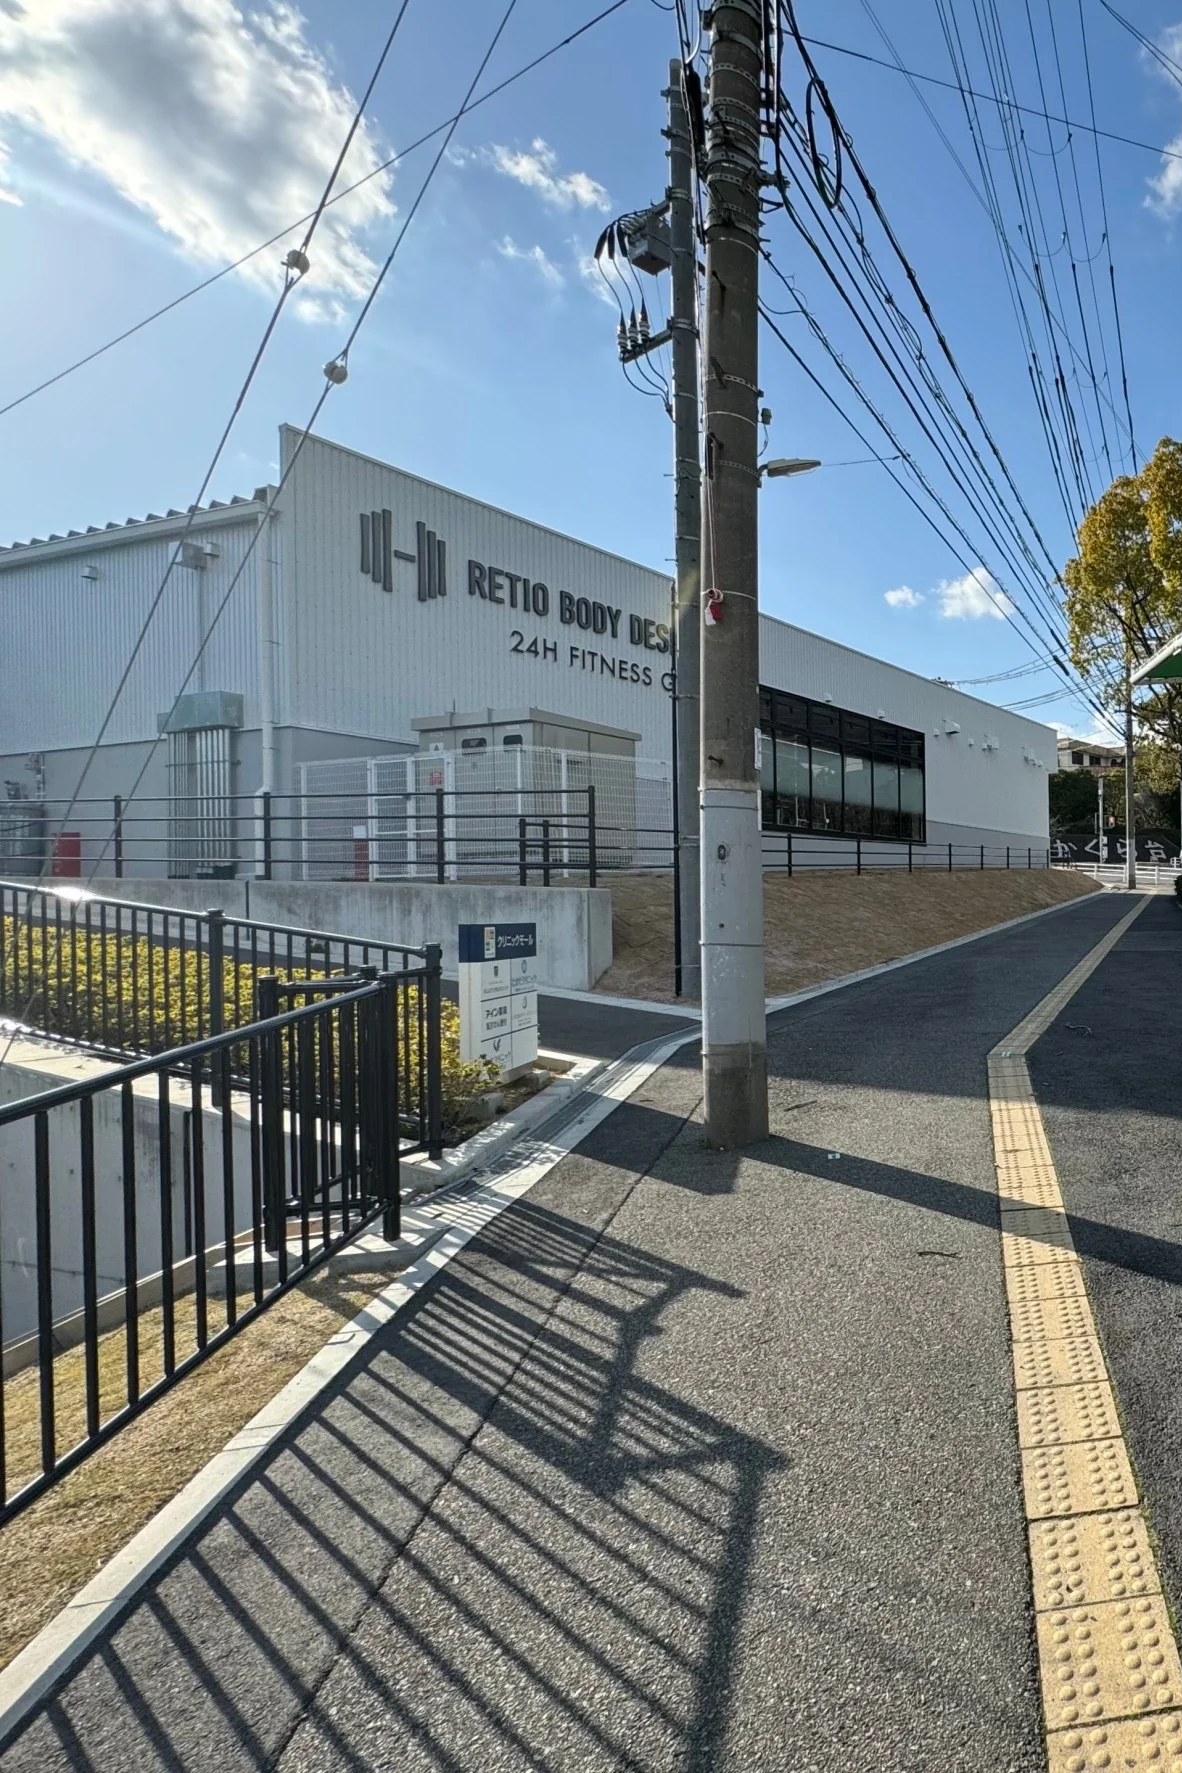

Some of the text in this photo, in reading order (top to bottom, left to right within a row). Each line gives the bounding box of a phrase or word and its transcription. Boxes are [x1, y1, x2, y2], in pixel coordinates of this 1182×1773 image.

[468, 559, 673, 655] RETIO BODY DES
[510, 630, 558, 662] 24H
[570, 646, 653, 686] FITNESS
[498, 934, 533, 948] クリニックモール
